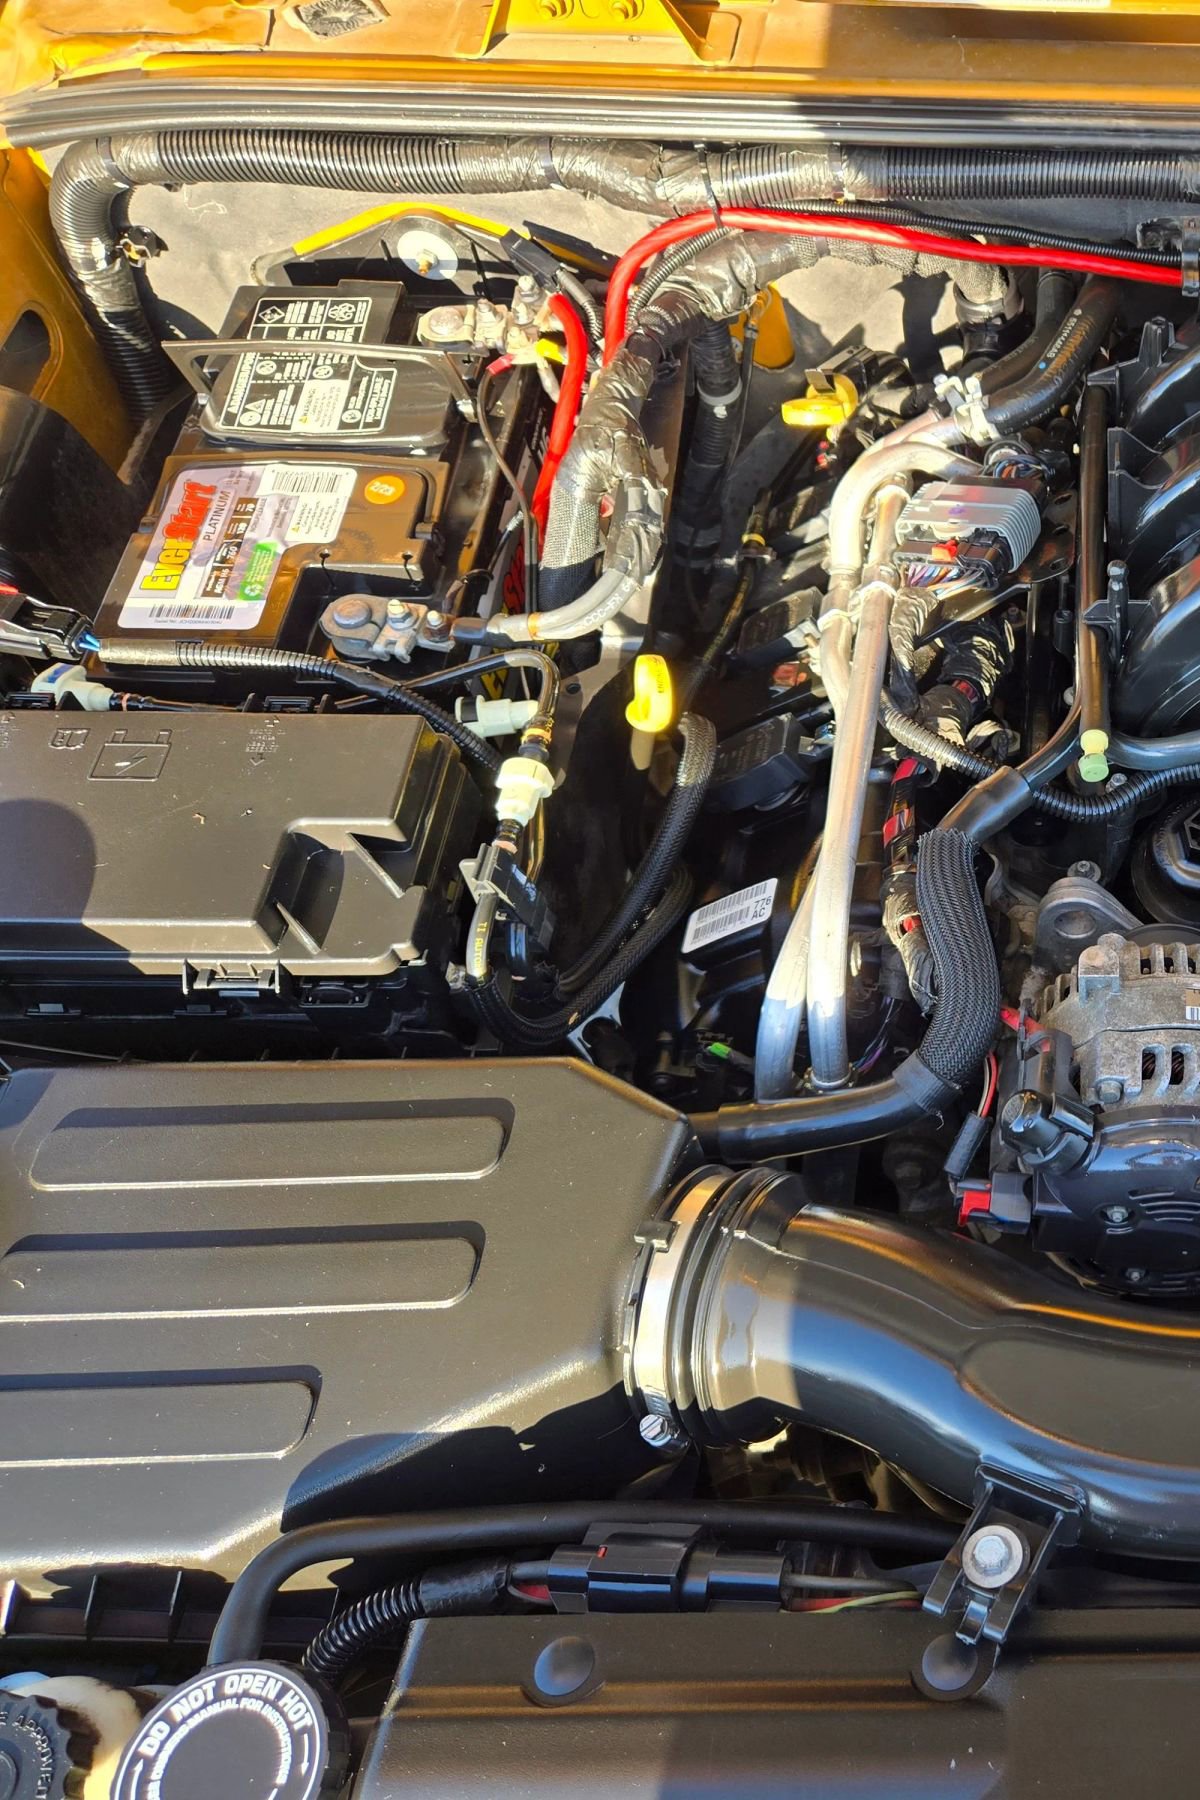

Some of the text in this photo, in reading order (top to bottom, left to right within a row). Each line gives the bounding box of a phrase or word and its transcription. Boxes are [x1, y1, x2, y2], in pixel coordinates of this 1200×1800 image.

[202, 491, 231, 541] PLATINUM
[226, 545, 238, 559] 760
[753, 896, 773, 910] 776
[750, 907, 766, 921] AC
[477, 921, 488, 932] TI
[137, 1673, 314, 1758] DO NOT OPEN HOT
[239, 1697, 264, 1712] FOR
[260, 1703, 293, 1786] INSTRUCTIONS
